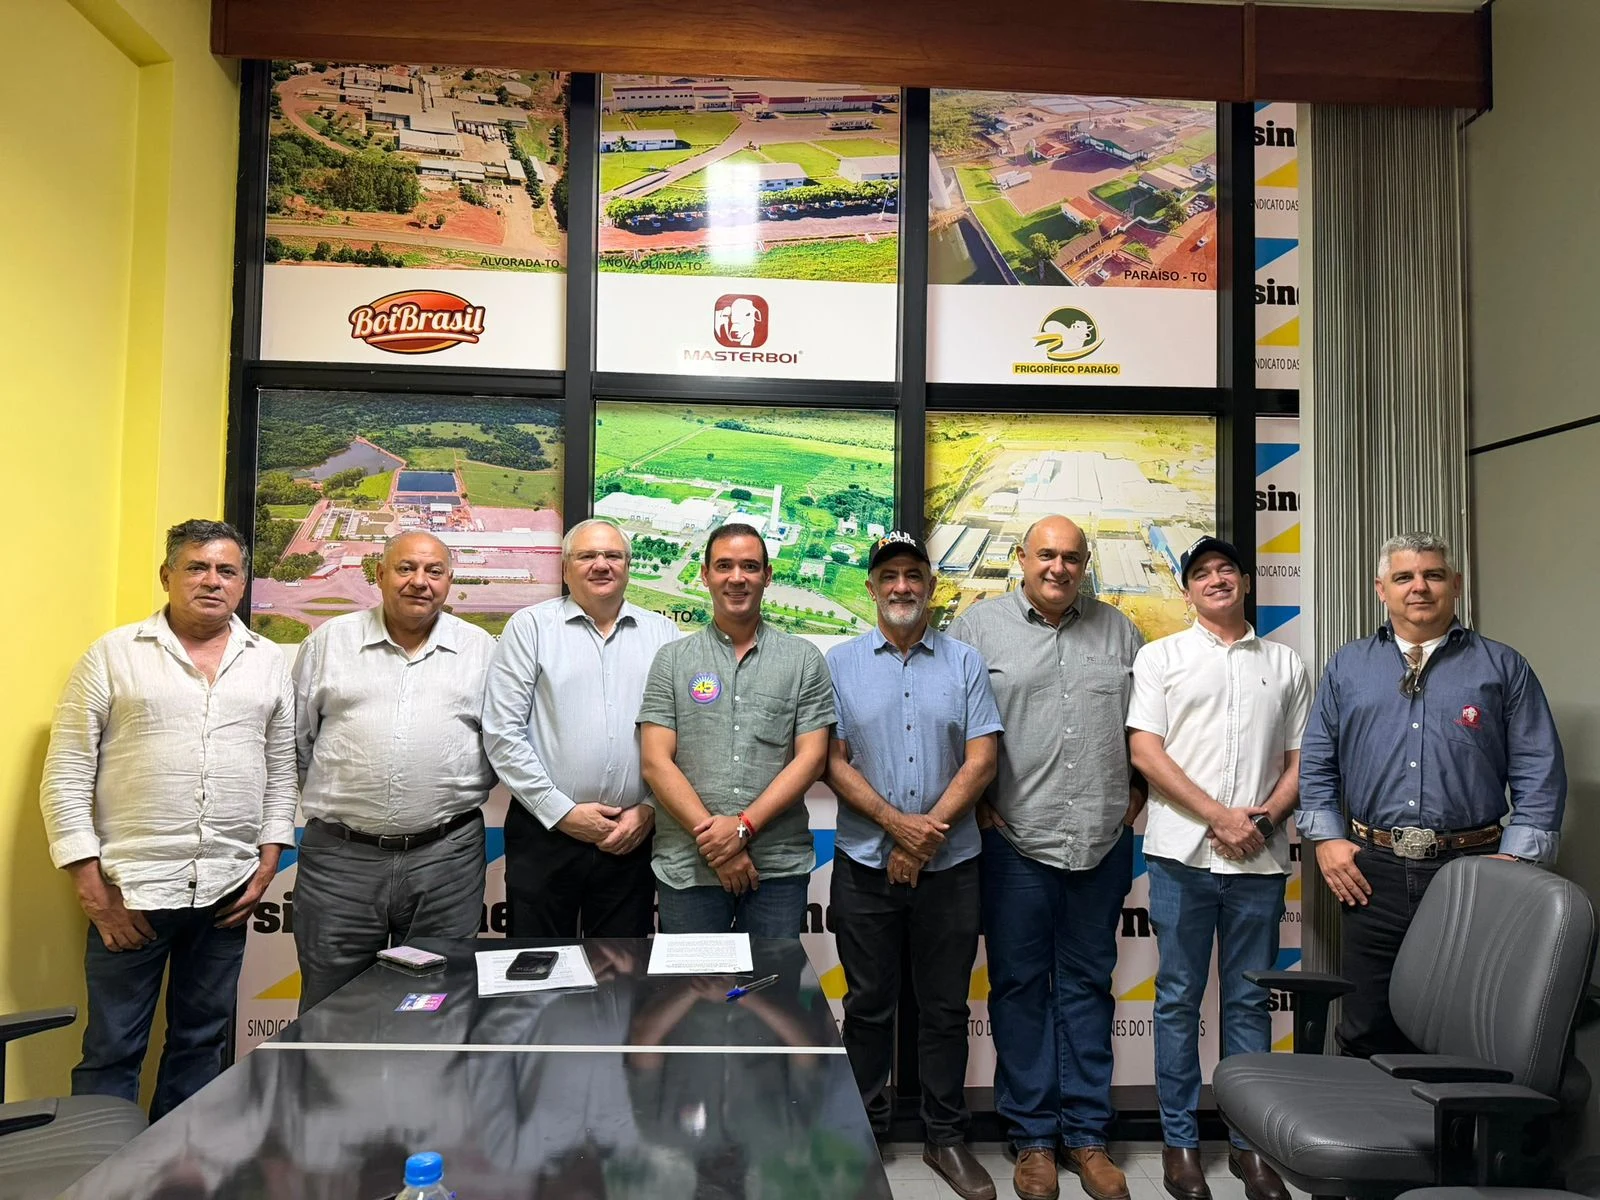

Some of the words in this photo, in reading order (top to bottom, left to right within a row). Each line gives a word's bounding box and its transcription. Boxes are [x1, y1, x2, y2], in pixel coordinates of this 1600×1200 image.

[1254, 120, 1298, 147] sin
[1254, 198, 1284, 210] NDICATO
[480, 257, 560, 268] ALVORADA-TO
[606, 258, 638, 269] NOVA
[641, 259, 703, 271] OLINDA-TO
[1124, 269, 1180, 282] PARAÍSO
[1191, 271, 1207, 282] TO
[1254, 278, 1299, 305] sin
[349, 302, 486, 338] BoiBrasil
[683, 349, 798, 364] MASTERBOI
[1014, 363, 1075, 374] FRIGORÍFICO
[1077, 364, 1119, 374] PARAÍSO
[1255, 358, 1285, 370] NDICATO
[1256, 484, 1301, 511] sin
[1256, 565, 1287, 577] NDICATO
